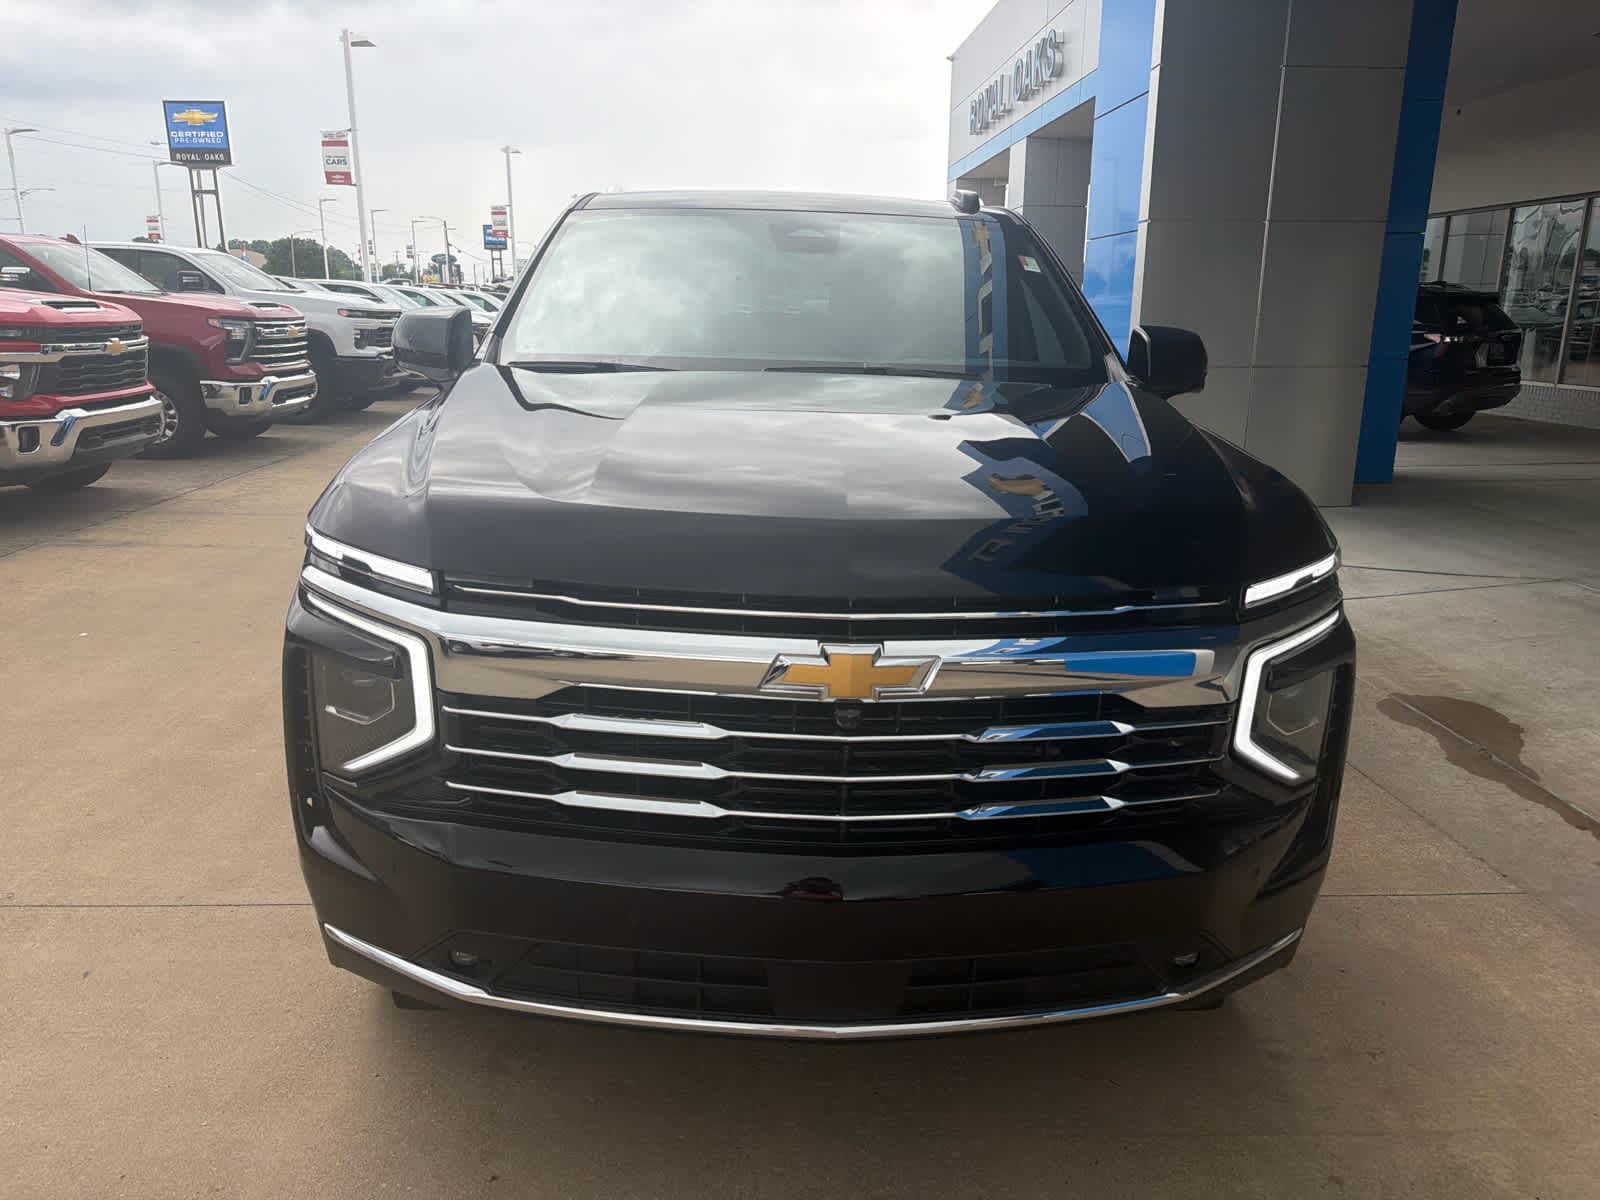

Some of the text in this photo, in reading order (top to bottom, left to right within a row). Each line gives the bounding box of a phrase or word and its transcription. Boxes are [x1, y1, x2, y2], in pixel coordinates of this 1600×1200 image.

[969, 28, 1063, 135] ROYAL OAKS
[175, 153, 201, 161] ROYAL
